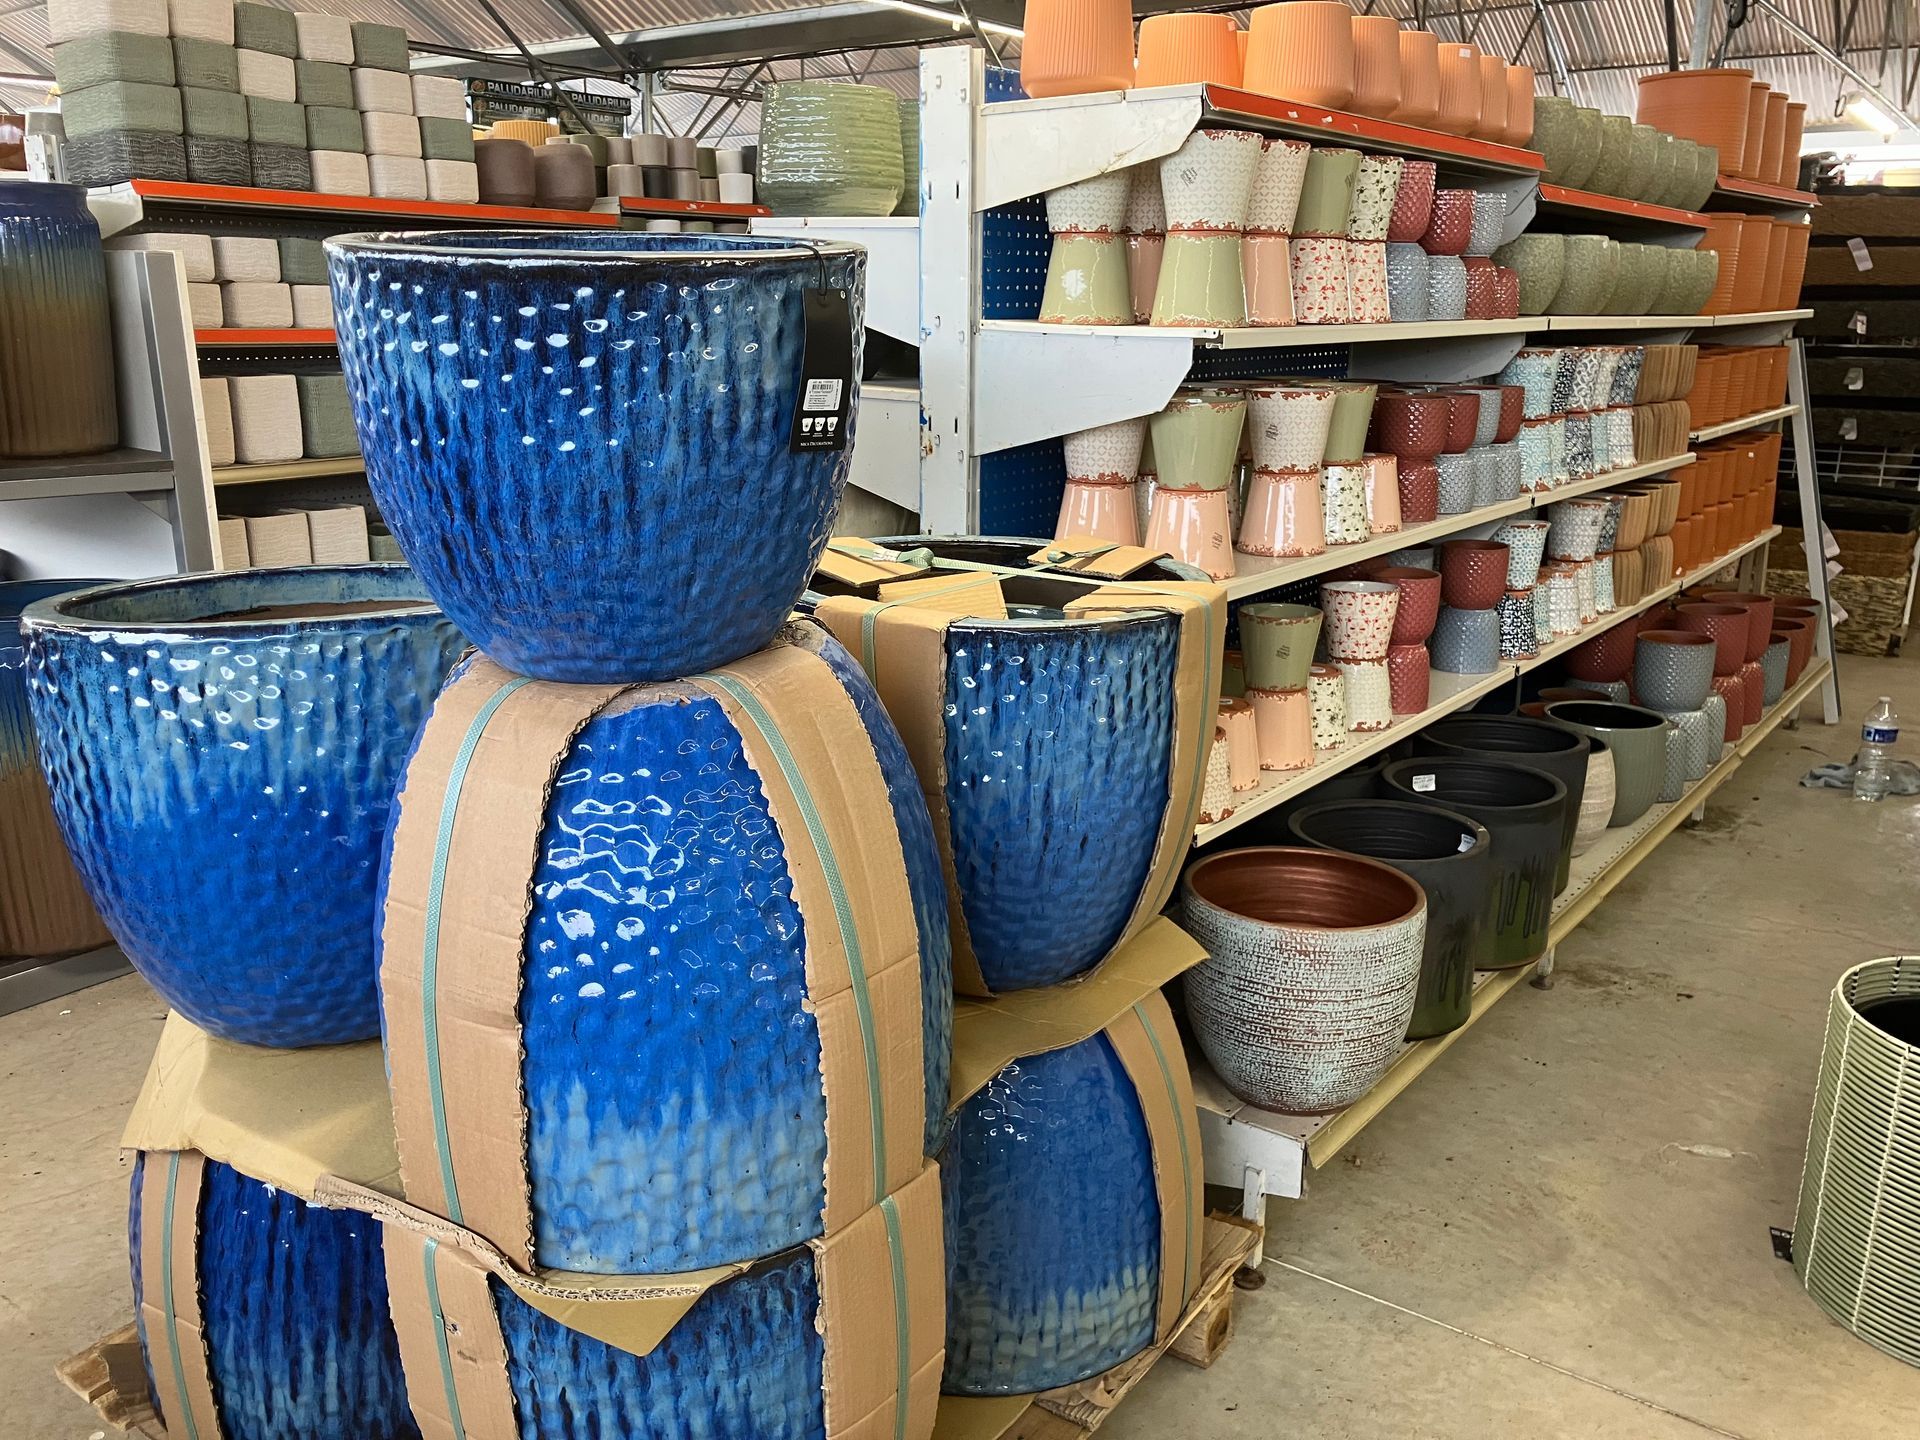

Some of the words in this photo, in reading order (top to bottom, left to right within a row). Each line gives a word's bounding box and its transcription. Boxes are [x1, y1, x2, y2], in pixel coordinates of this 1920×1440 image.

[487, 81, 552, 98] PALUDARIUM
[489, 101, 546, 116] PALUDARIUM
[572, 93, 630, 109] PALUDARIUM
